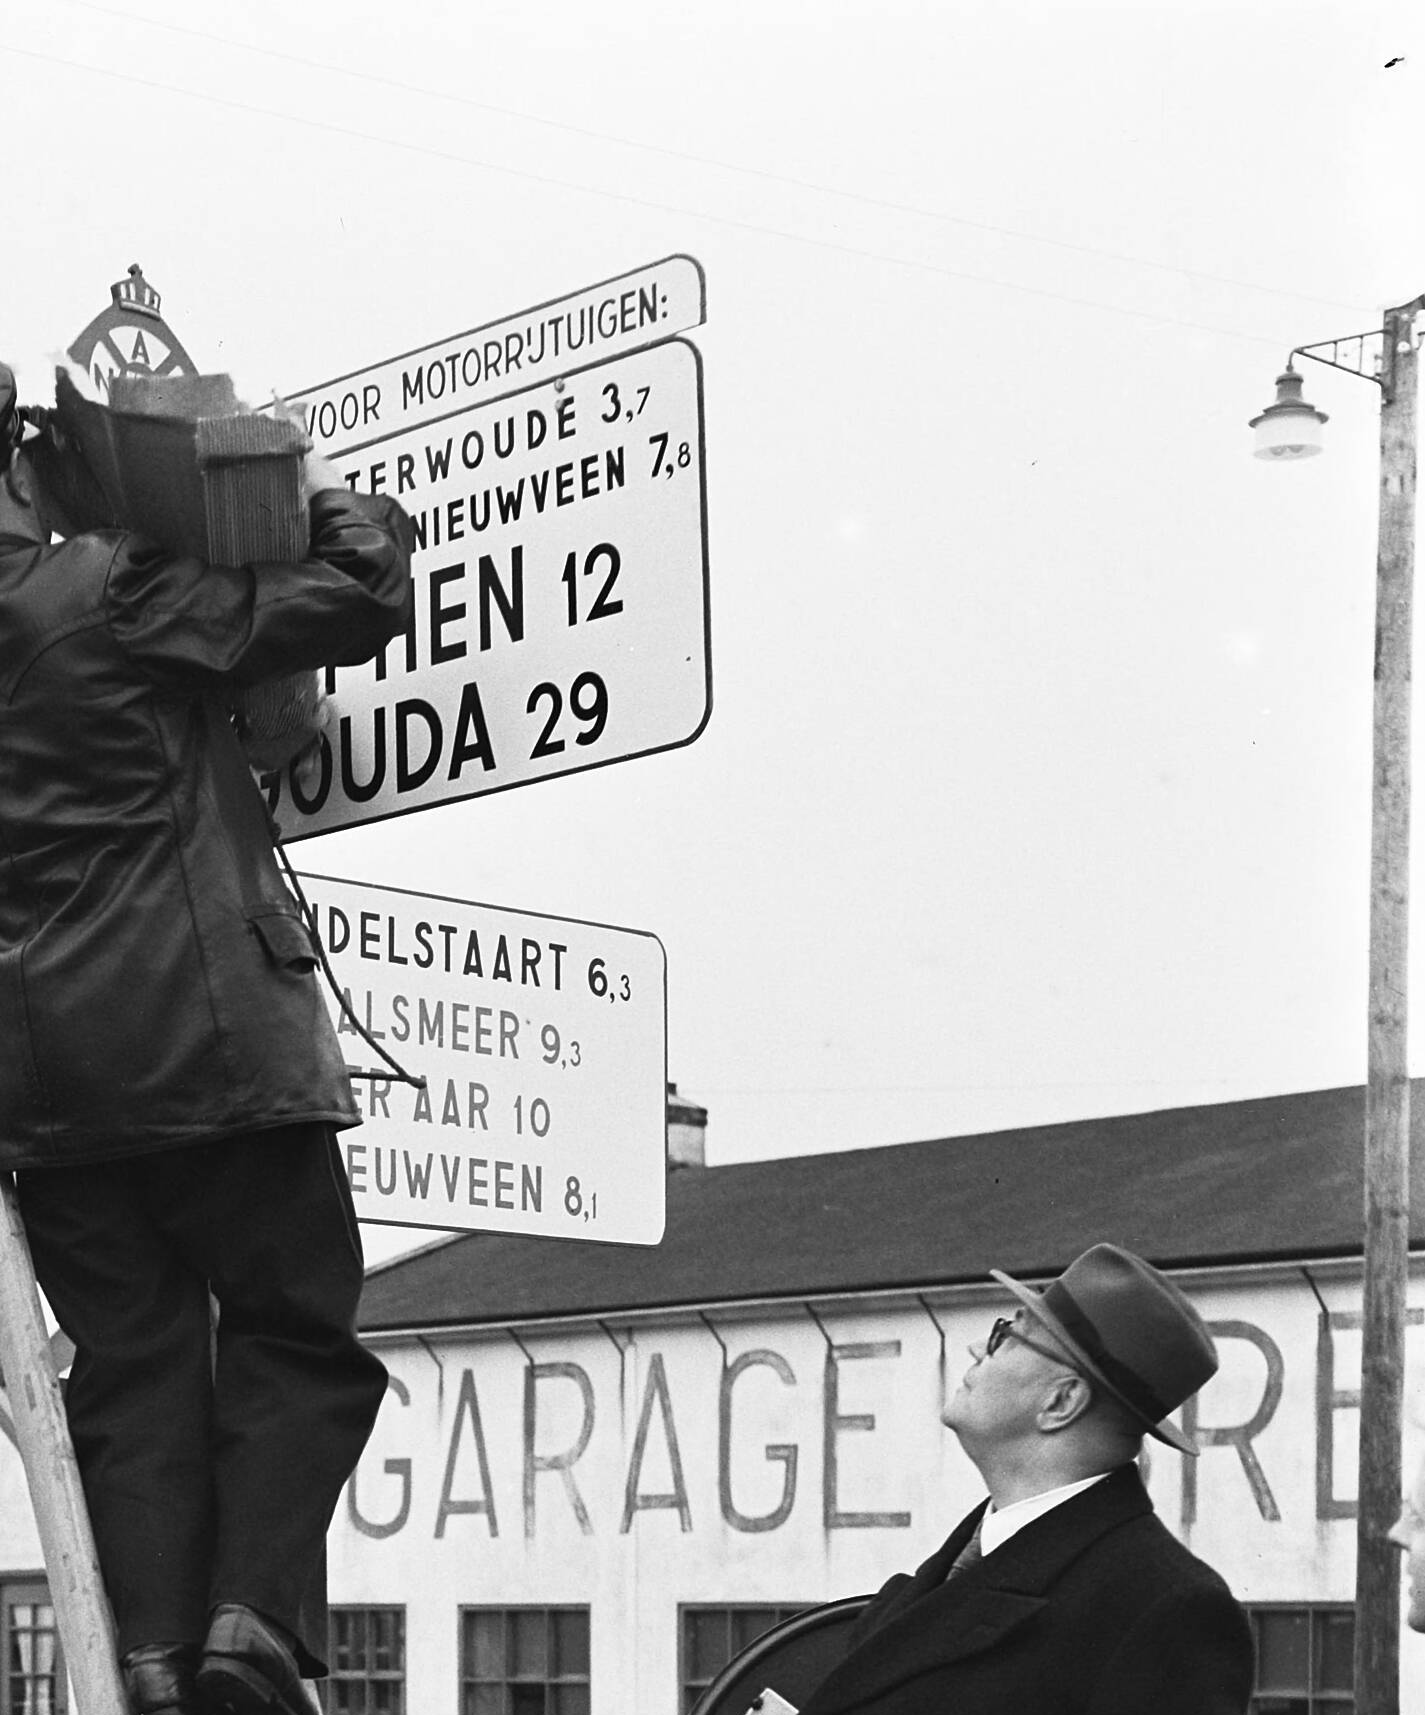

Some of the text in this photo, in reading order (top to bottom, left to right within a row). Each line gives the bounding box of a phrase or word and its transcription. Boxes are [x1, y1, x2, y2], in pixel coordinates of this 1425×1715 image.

[601, 382, 651, 424] 3,7
[649, 432, 692, 480] 7,8
[561, 542, 624, 627] 12
[525, 670, 609, 761] 29
[587, 957, 632, 1002] 6,3
[337, 986, 582, 1069] ALSMEER 9,3
[413, 1074, 489, 1131] AAR
[512, 1095, 551, 1138] 10
[564, 1175, 598, 1223] 8,1
[347, 1338, 911, 1540] GARAGE
